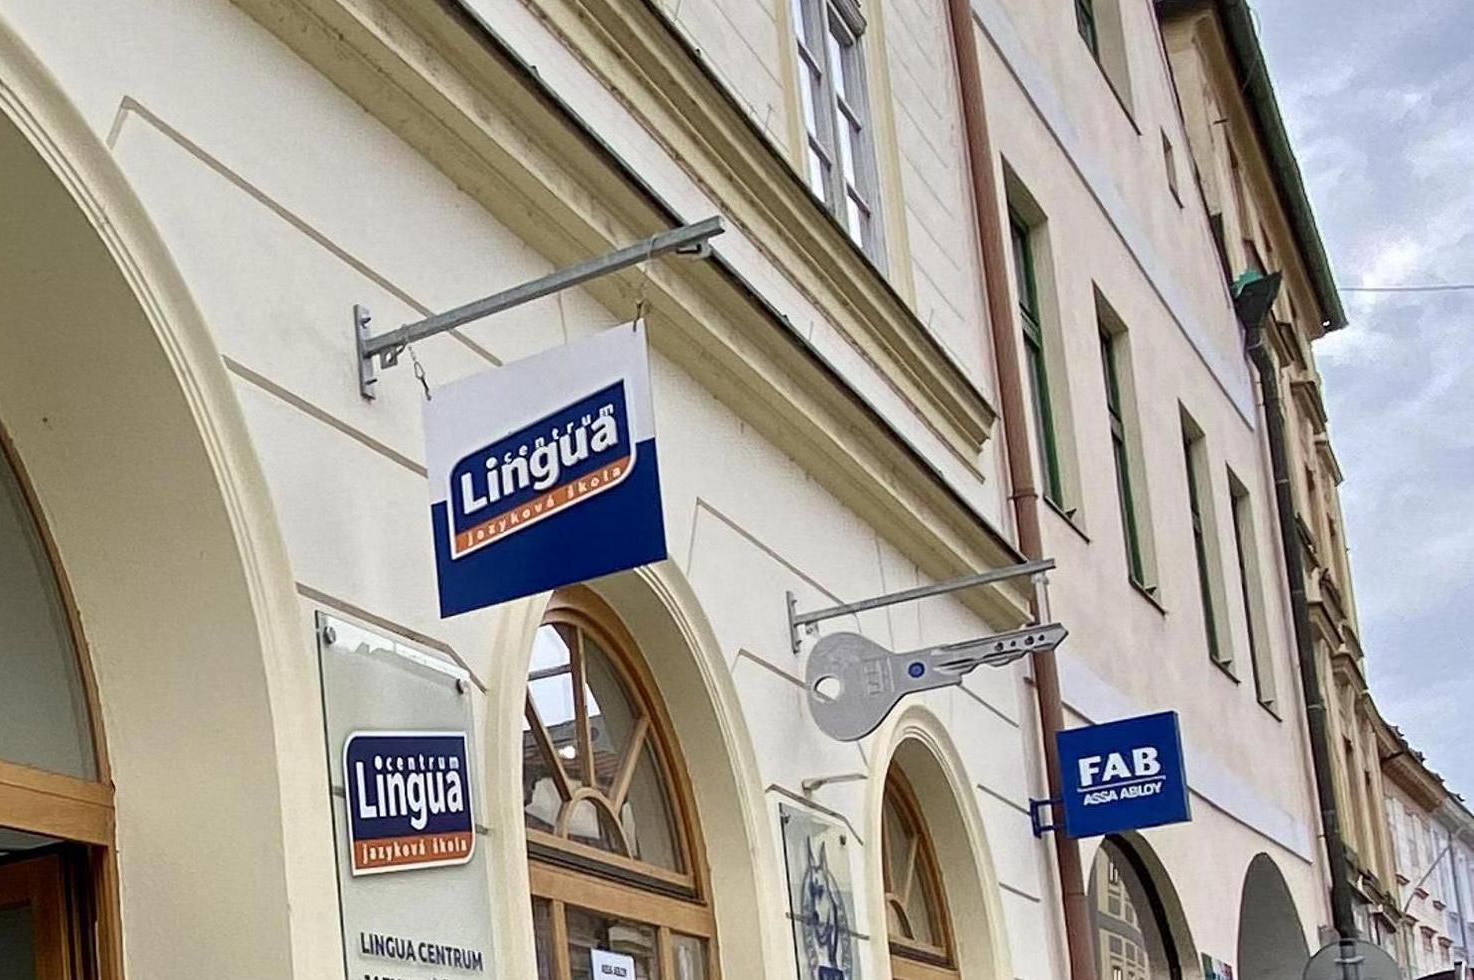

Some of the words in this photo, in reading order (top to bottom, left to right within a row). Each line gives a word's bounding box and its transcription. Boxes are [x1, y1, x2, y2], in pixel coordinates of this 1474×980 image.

[460, 414, 619, 516] Lingua
[466, 495, 555, 547] jazyková
[386, 754, 460, 771] centrum
[1077, 746, 1162, 788] FAB
[355, 755, 464, 831] Lingua
[1083, 789, 1118, 806] ASSA
[1120, 781, 1163, 800] ABLOY
[362, 839, 426, 865] jazyková
[432, 837, 468, 854] škola
[360, 932, 416, 961] LINGUA
[419, 943, 484, 972] CENTRUM
